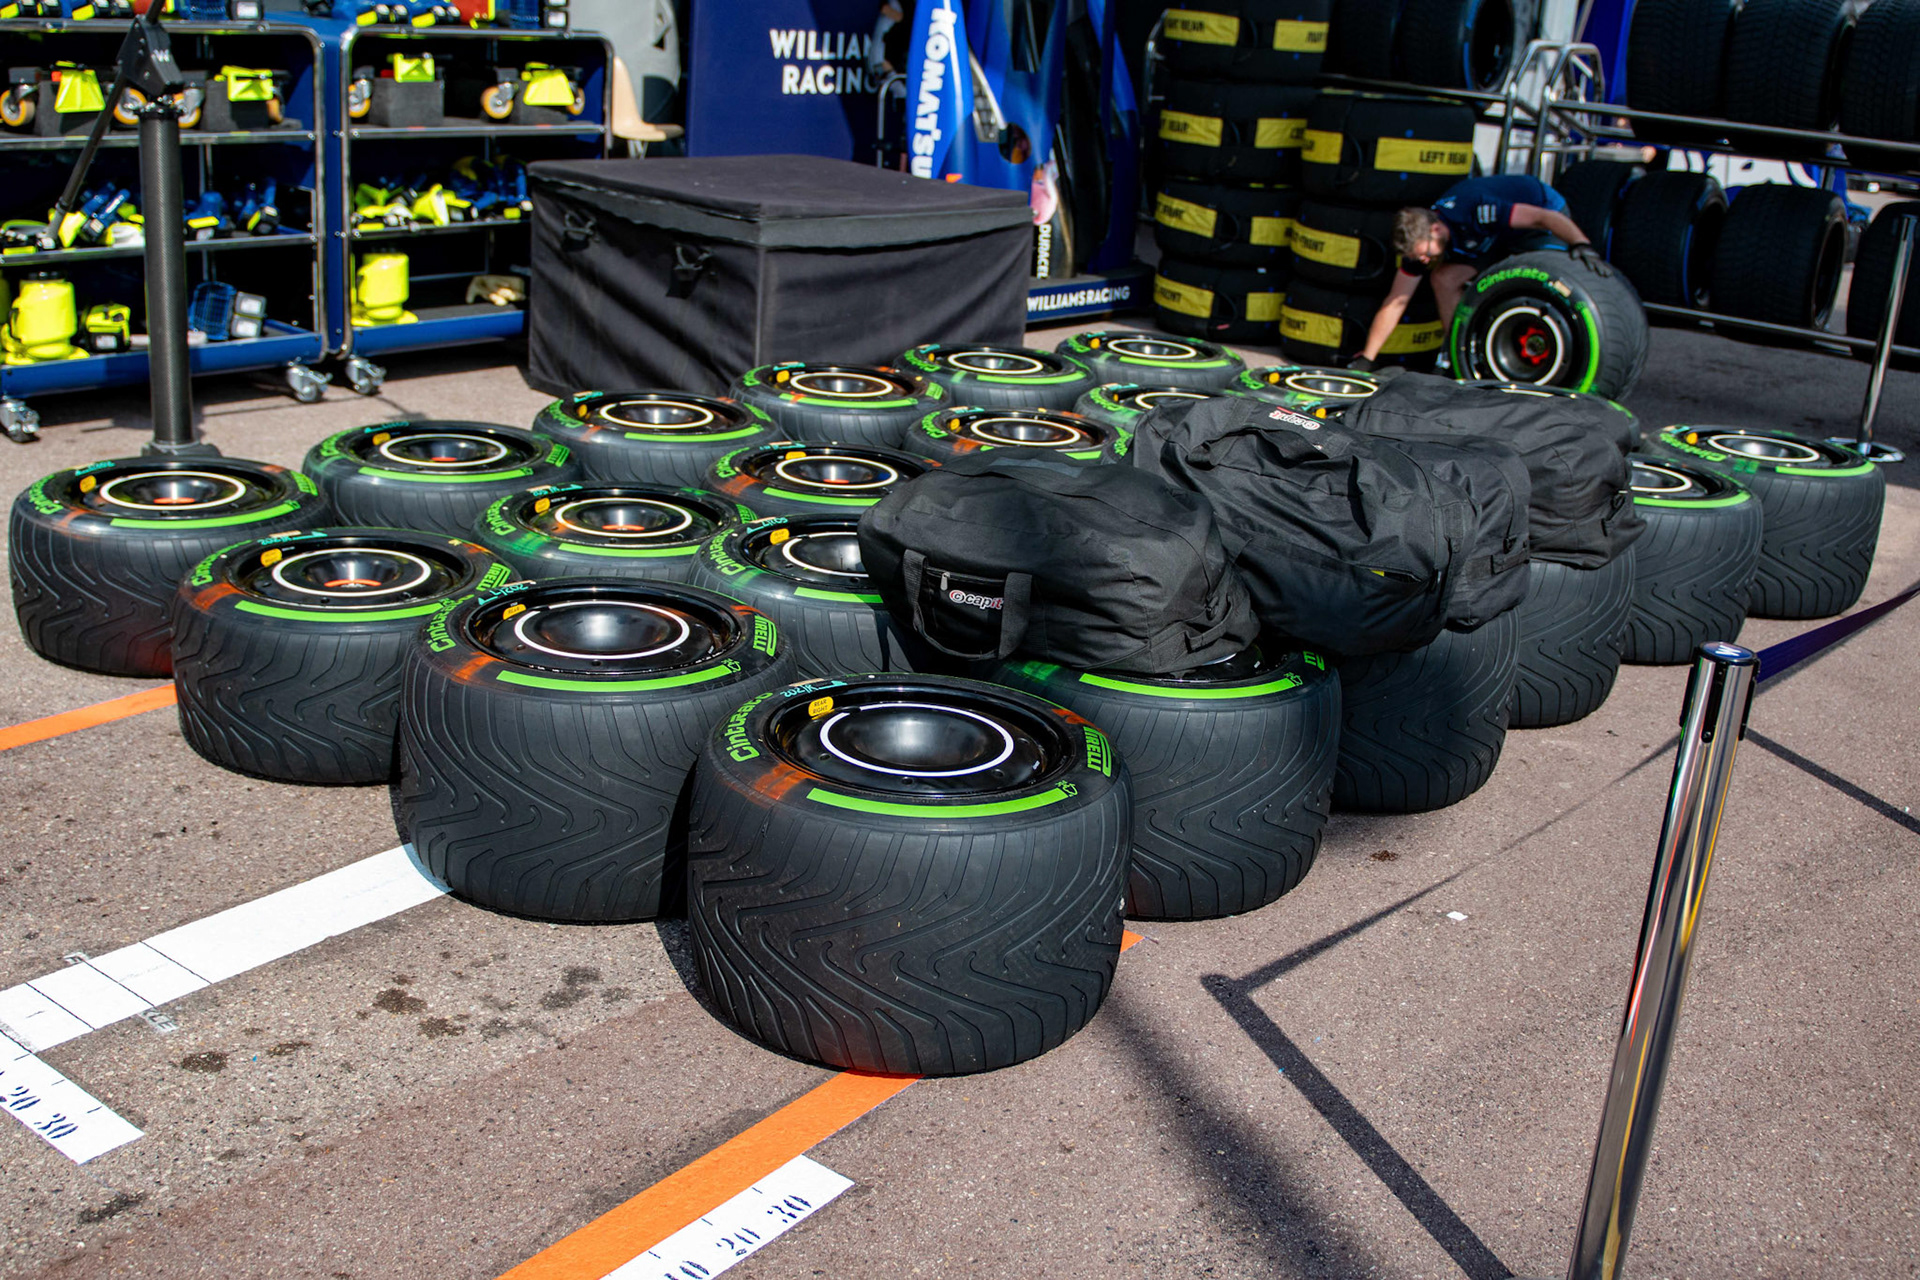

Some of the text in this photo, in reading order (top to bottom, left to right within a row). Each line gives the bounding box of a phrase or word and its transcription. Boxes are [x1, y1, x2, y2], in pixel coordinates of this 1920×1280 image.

[911, 8, 957, 179] KOMATSU
[1419, 151, 1444, 164] LEFT
[752, 615, 777, 657] PIRELLI
[812, 705, 828, 715] RIGHT
[814, 698, 827, 707] REAR
[725, 692, 774, 763] Cinturato
[1083, 726, 1112, 778] PIRELLI
[33, 1113, 79, 1140] 30
[715, 1227, 761, 1257] 20
[766, 1194, 813, 1224] 30
